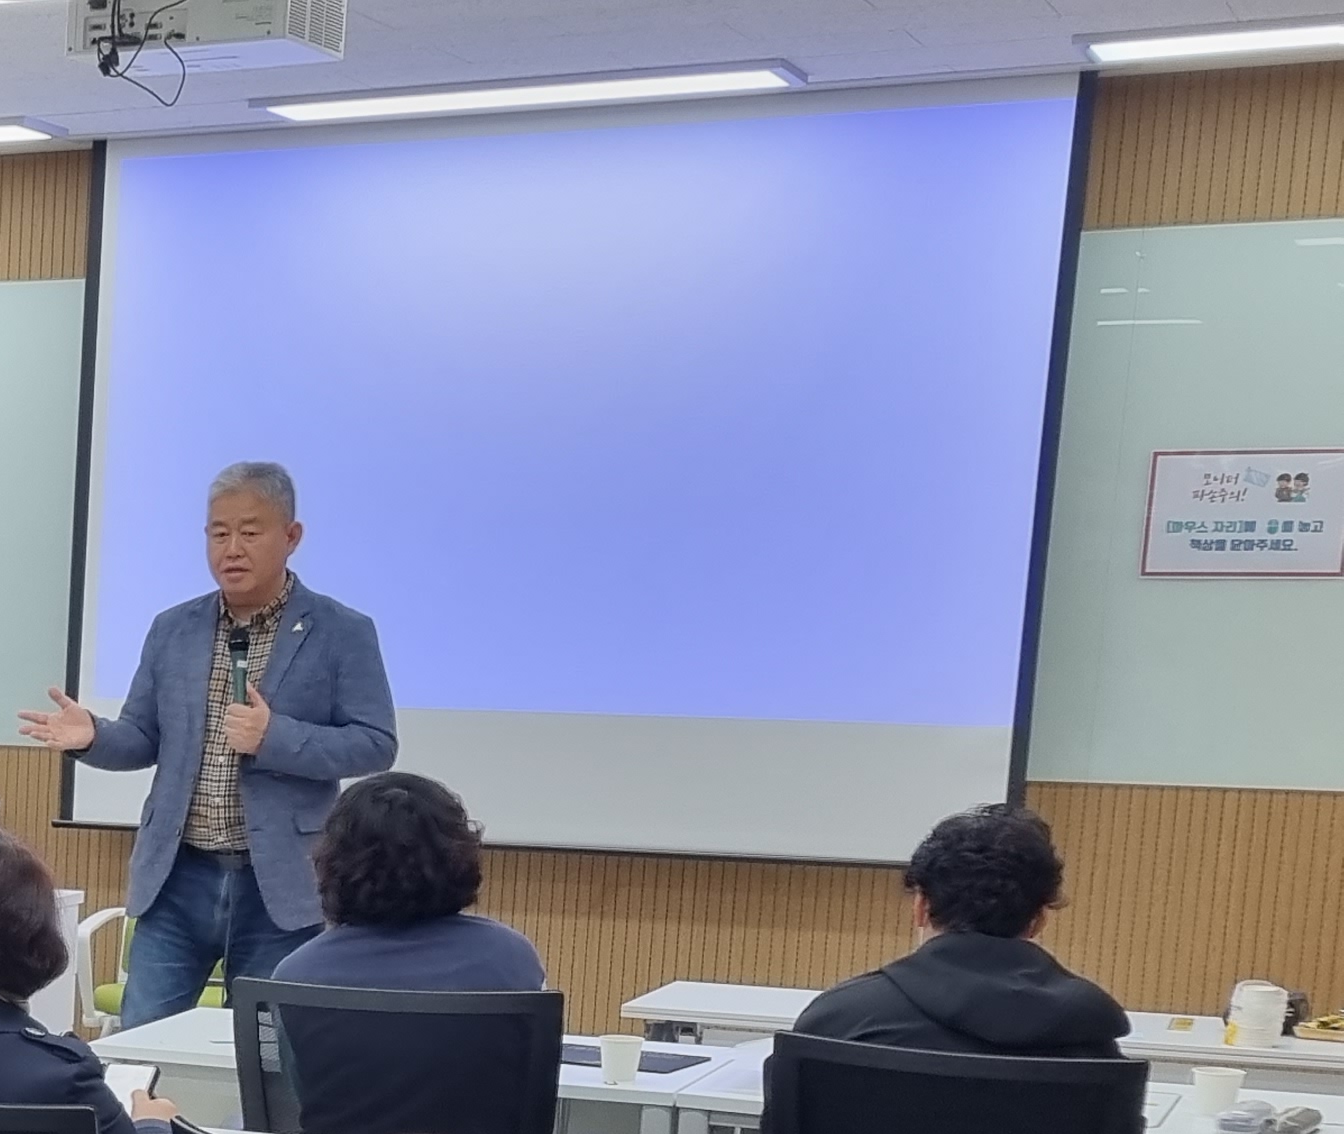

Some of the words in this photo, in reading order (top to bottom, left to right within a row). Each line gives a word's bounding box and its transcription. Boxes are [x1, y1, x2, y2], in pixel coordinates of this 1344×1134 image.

[1203, 473, 1240, 486] 모니터
[1192, 488, 1248, 503] 파손주의!
[1189, 538, 1227, 551] 책상을
